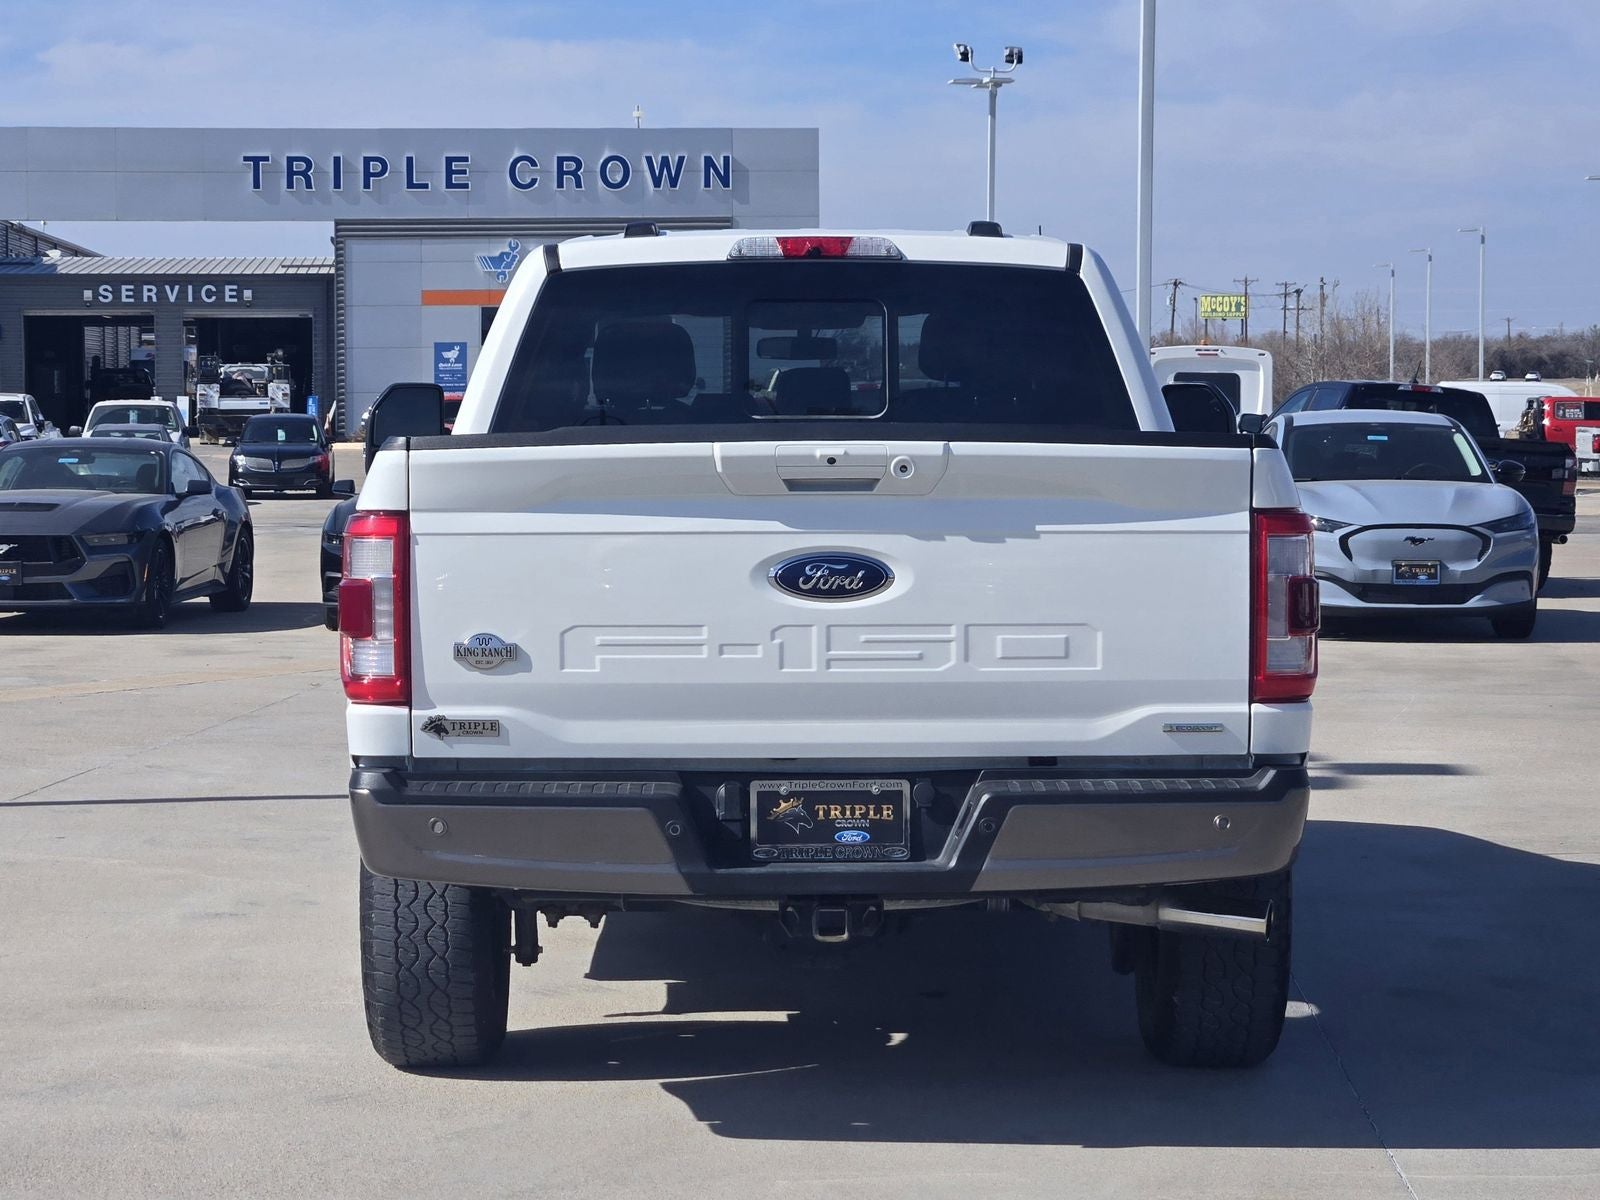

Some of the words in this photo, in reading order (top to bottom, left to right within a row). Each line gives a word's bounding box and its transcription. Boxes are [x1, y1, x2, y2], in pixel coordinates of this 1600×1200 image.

[243, 154, 470, 191] TRIPLE
[508, 153, 732, 191] CROWN
[98, 284, 238, 303] SERVICE
[798, 562, 866, 590] Ford
[456, 645, 479, 658] KING
[481, 646, 513, 658] RANCH
[560, 624, 1103, 672] F-150
[450, 721, 498, 732] TRIPLE
[815, 804, 894, 821] TRIPLE
[835, 819, 870, 828] CROWN
[778, 846, 833, 859] TRIPLE
[835, 846, 884, 859] CROWN
